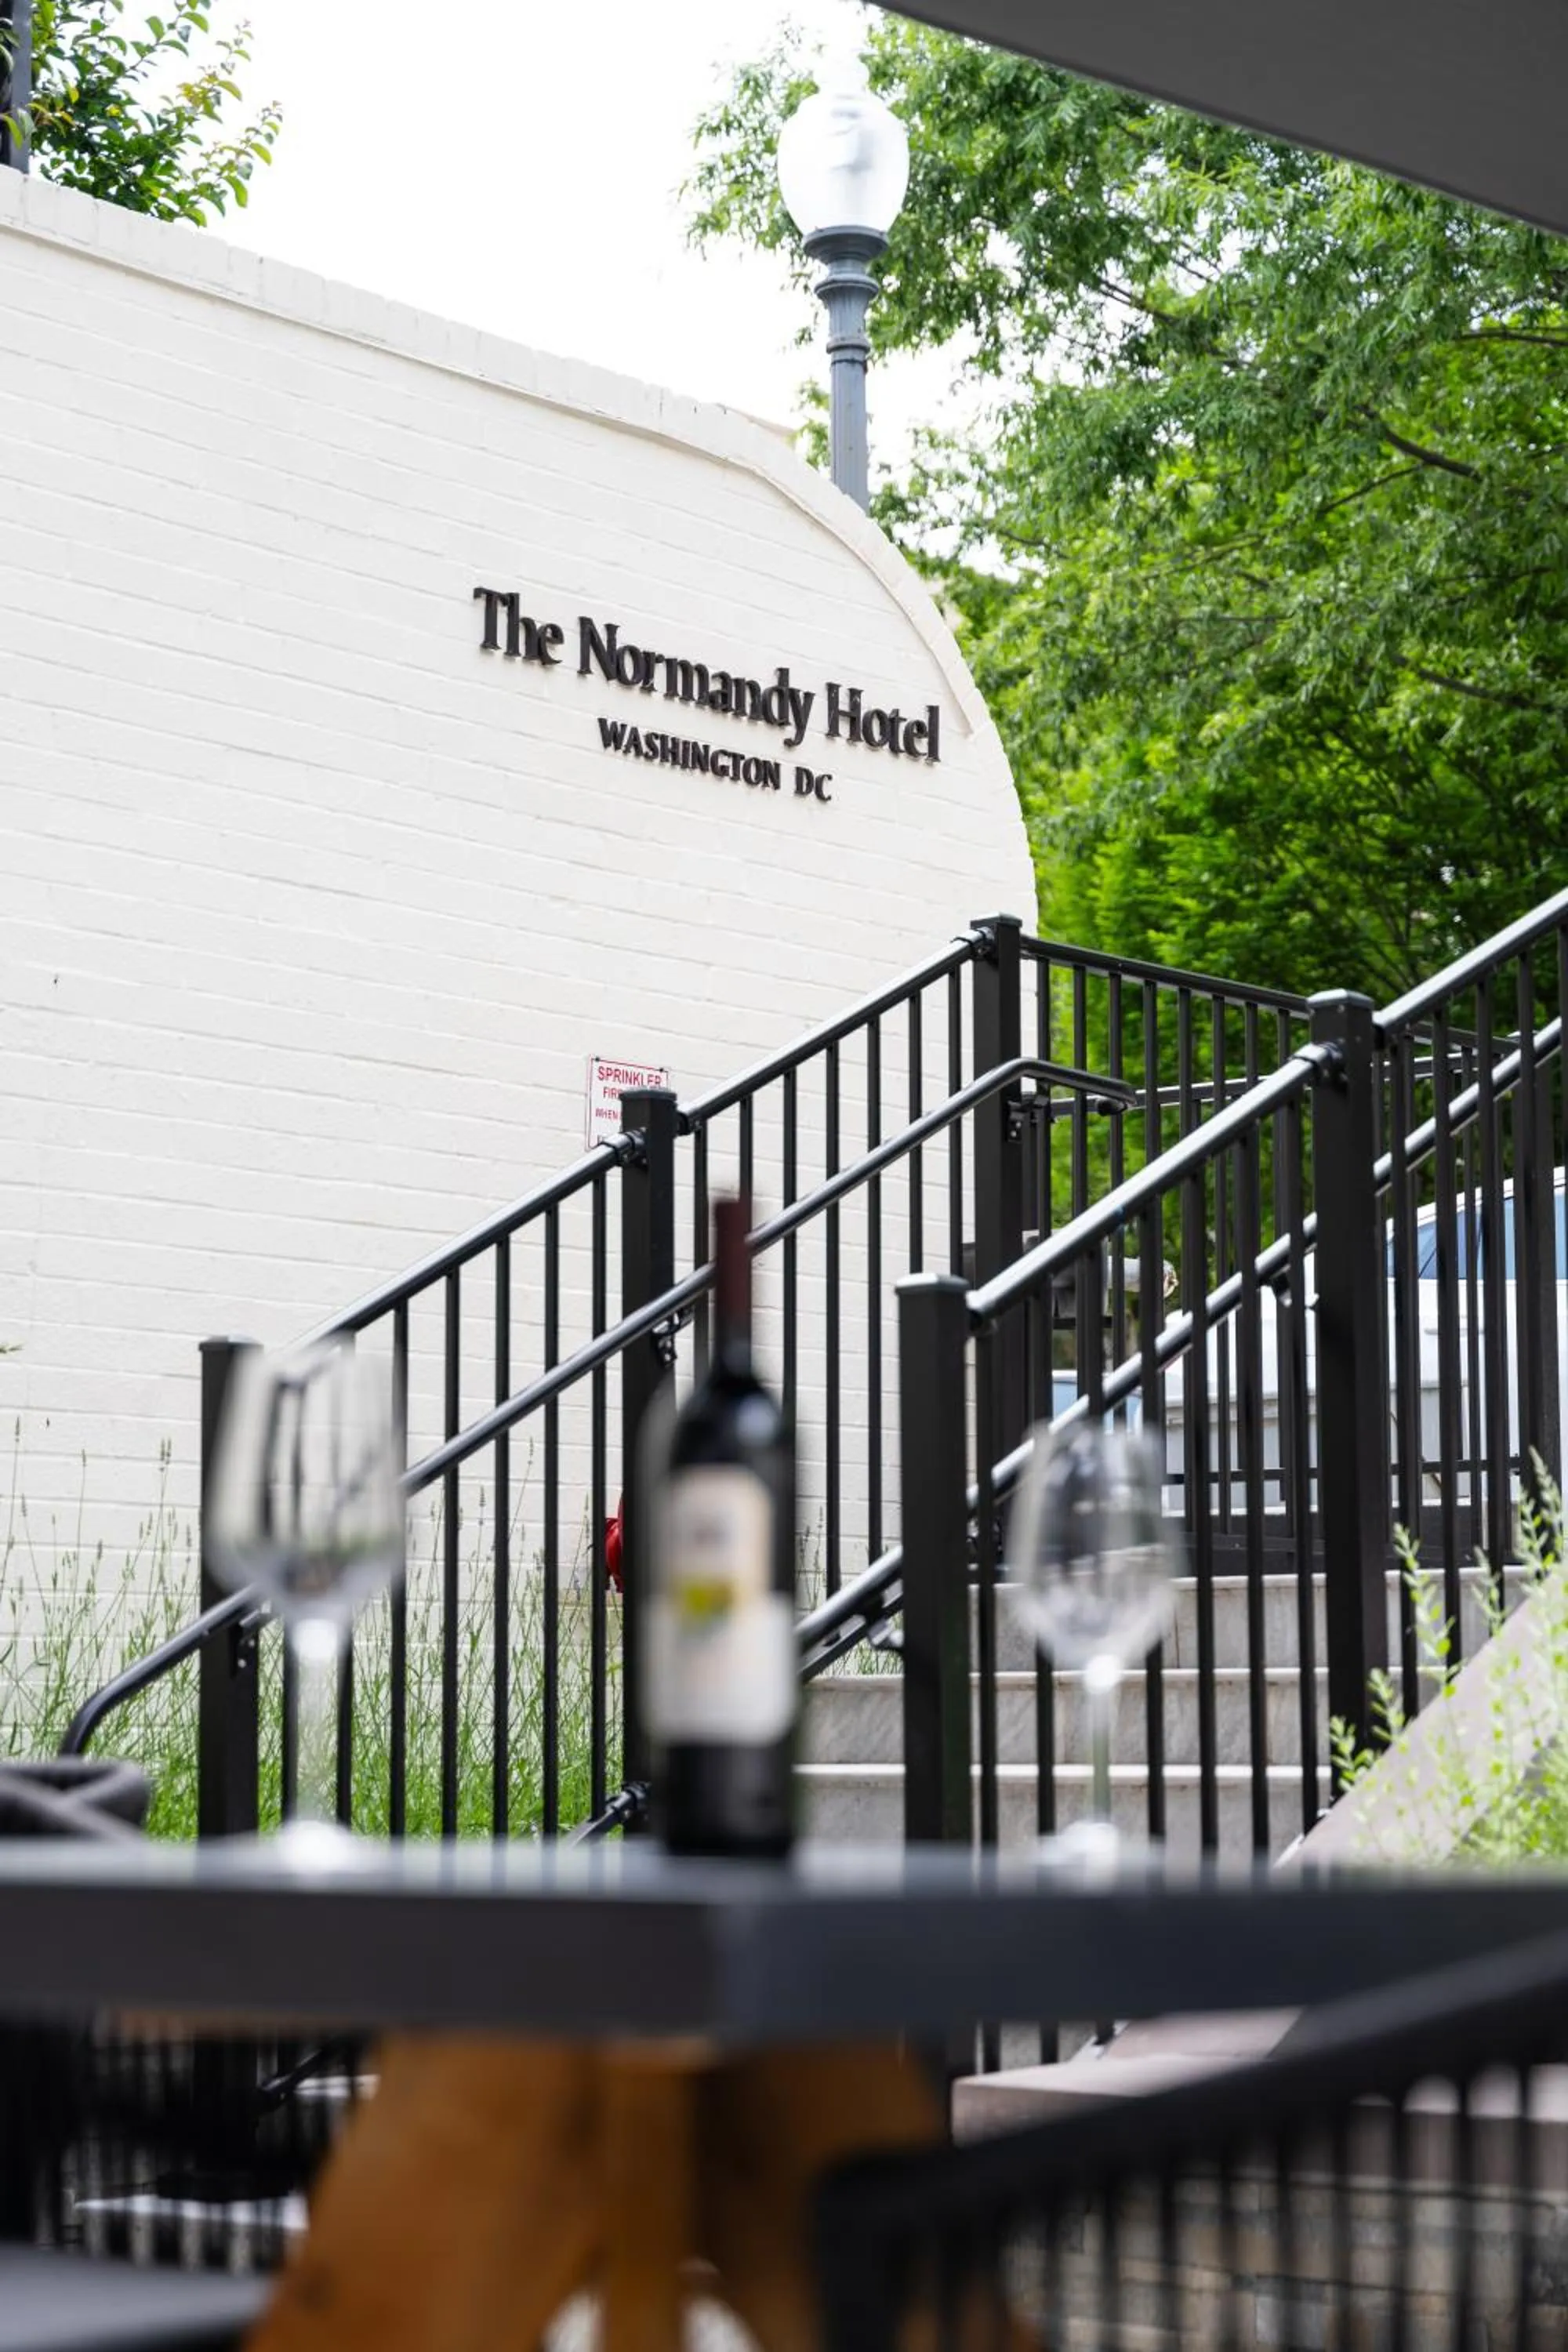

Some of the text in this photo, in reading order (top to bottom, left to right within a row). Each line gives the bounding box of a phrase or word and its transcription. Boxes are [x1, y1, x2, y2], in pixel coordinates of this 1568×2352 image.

[474, 588, 939, 763] The Normandy Hotel
[597, 717, 833, 801] WASHINGTON DC
[595, 1108, 619, 1121] WHEN
